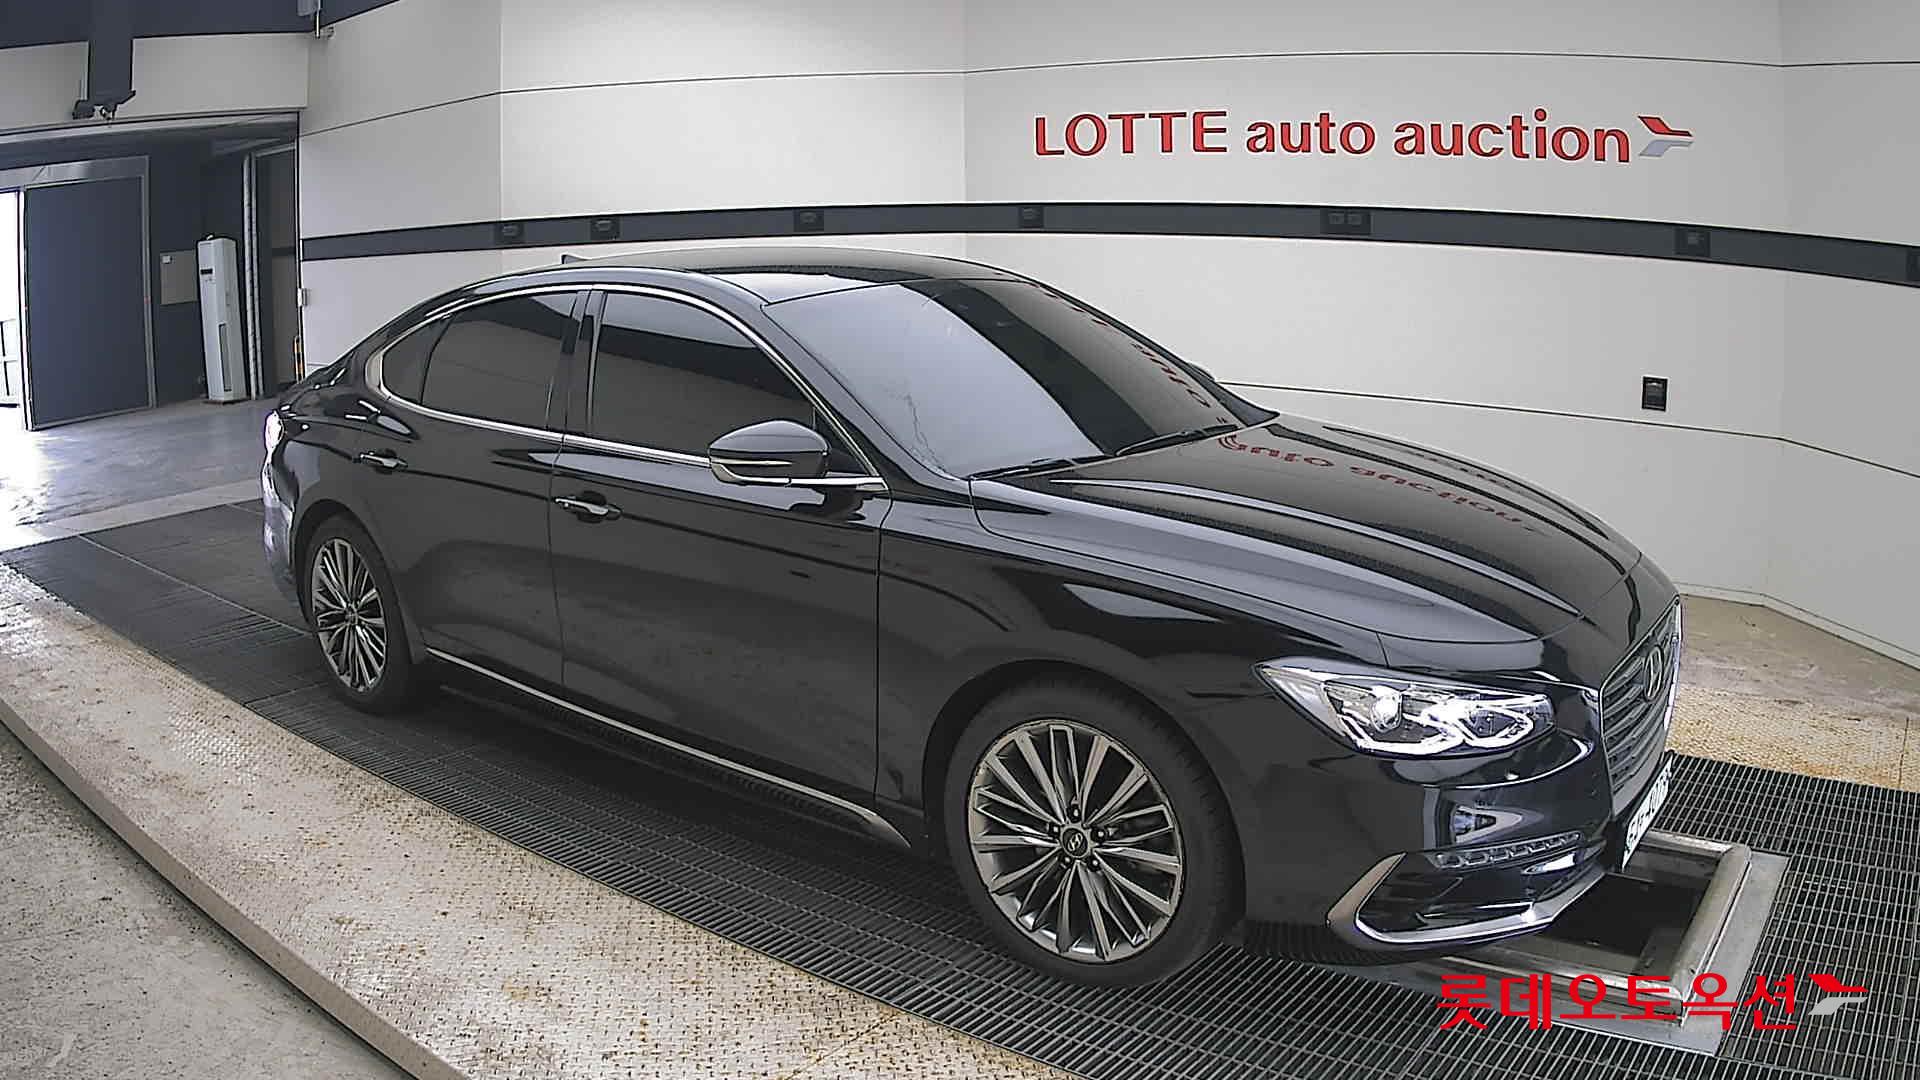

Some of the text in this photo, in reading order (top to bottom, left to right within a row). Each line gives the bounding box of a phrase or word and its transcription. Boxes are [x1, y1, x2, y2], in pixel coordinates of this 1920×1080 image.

[1035, 108, 1631, 163] LOTTE auto auction
